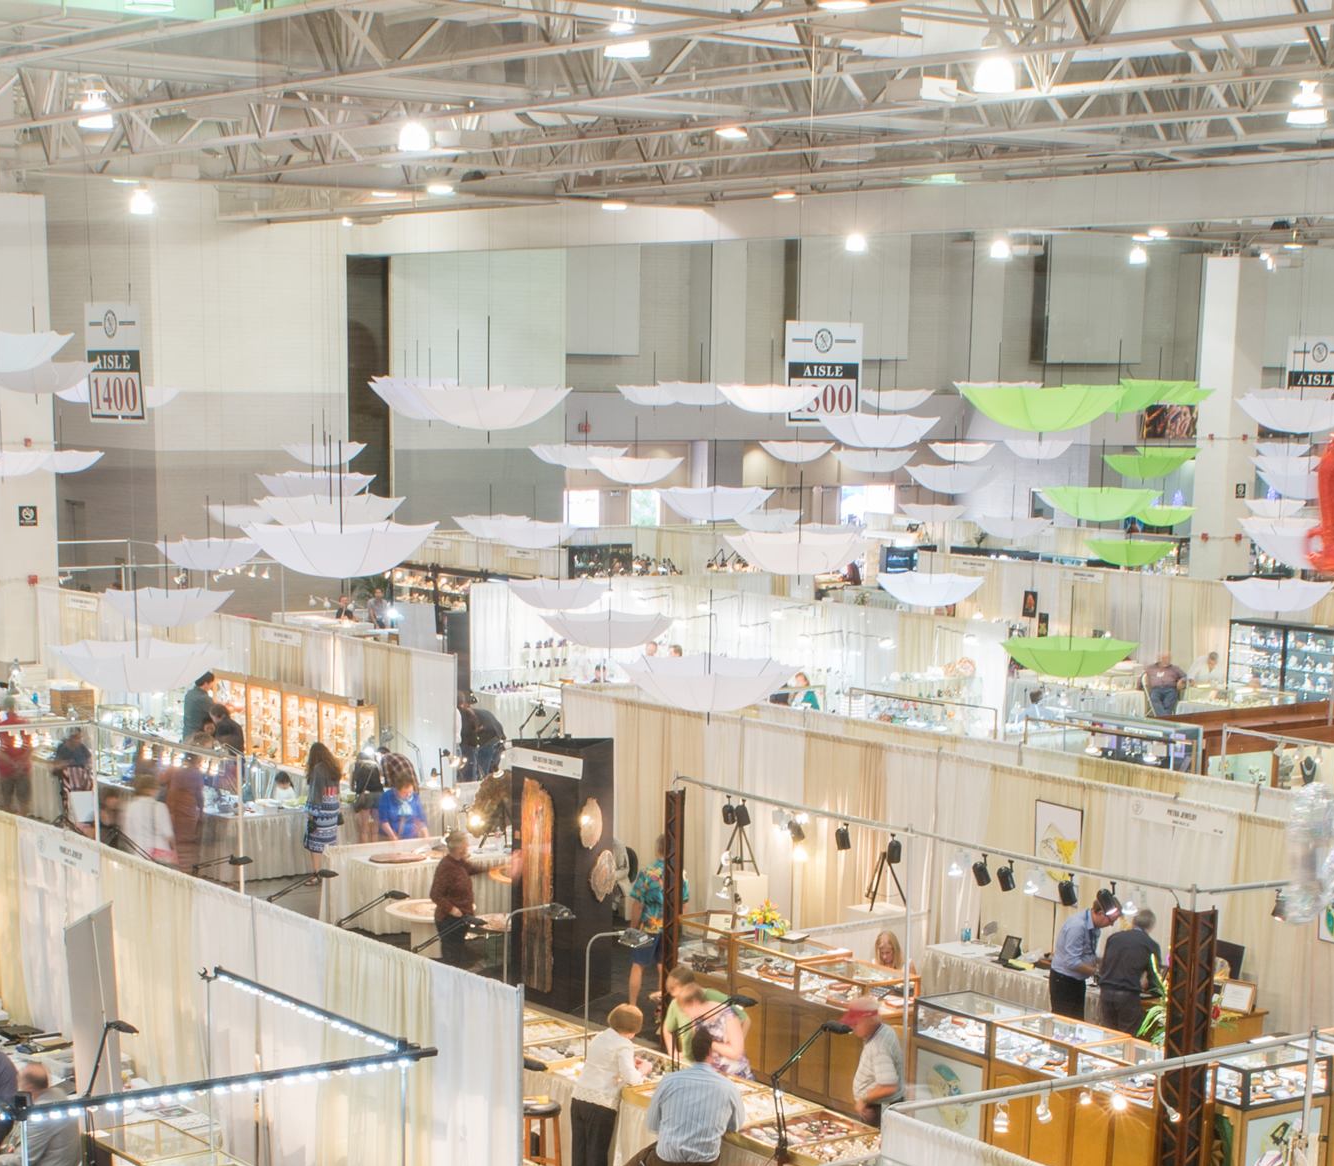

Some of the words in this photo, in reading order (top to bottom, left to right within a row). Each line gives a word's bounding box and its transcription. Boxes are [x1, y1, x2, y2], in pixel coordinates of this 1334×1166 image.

[94, 354, 131, 369] AISLE
[803, 365, 843, 377] AISLE
[93, 377, 138, 411] 1400
